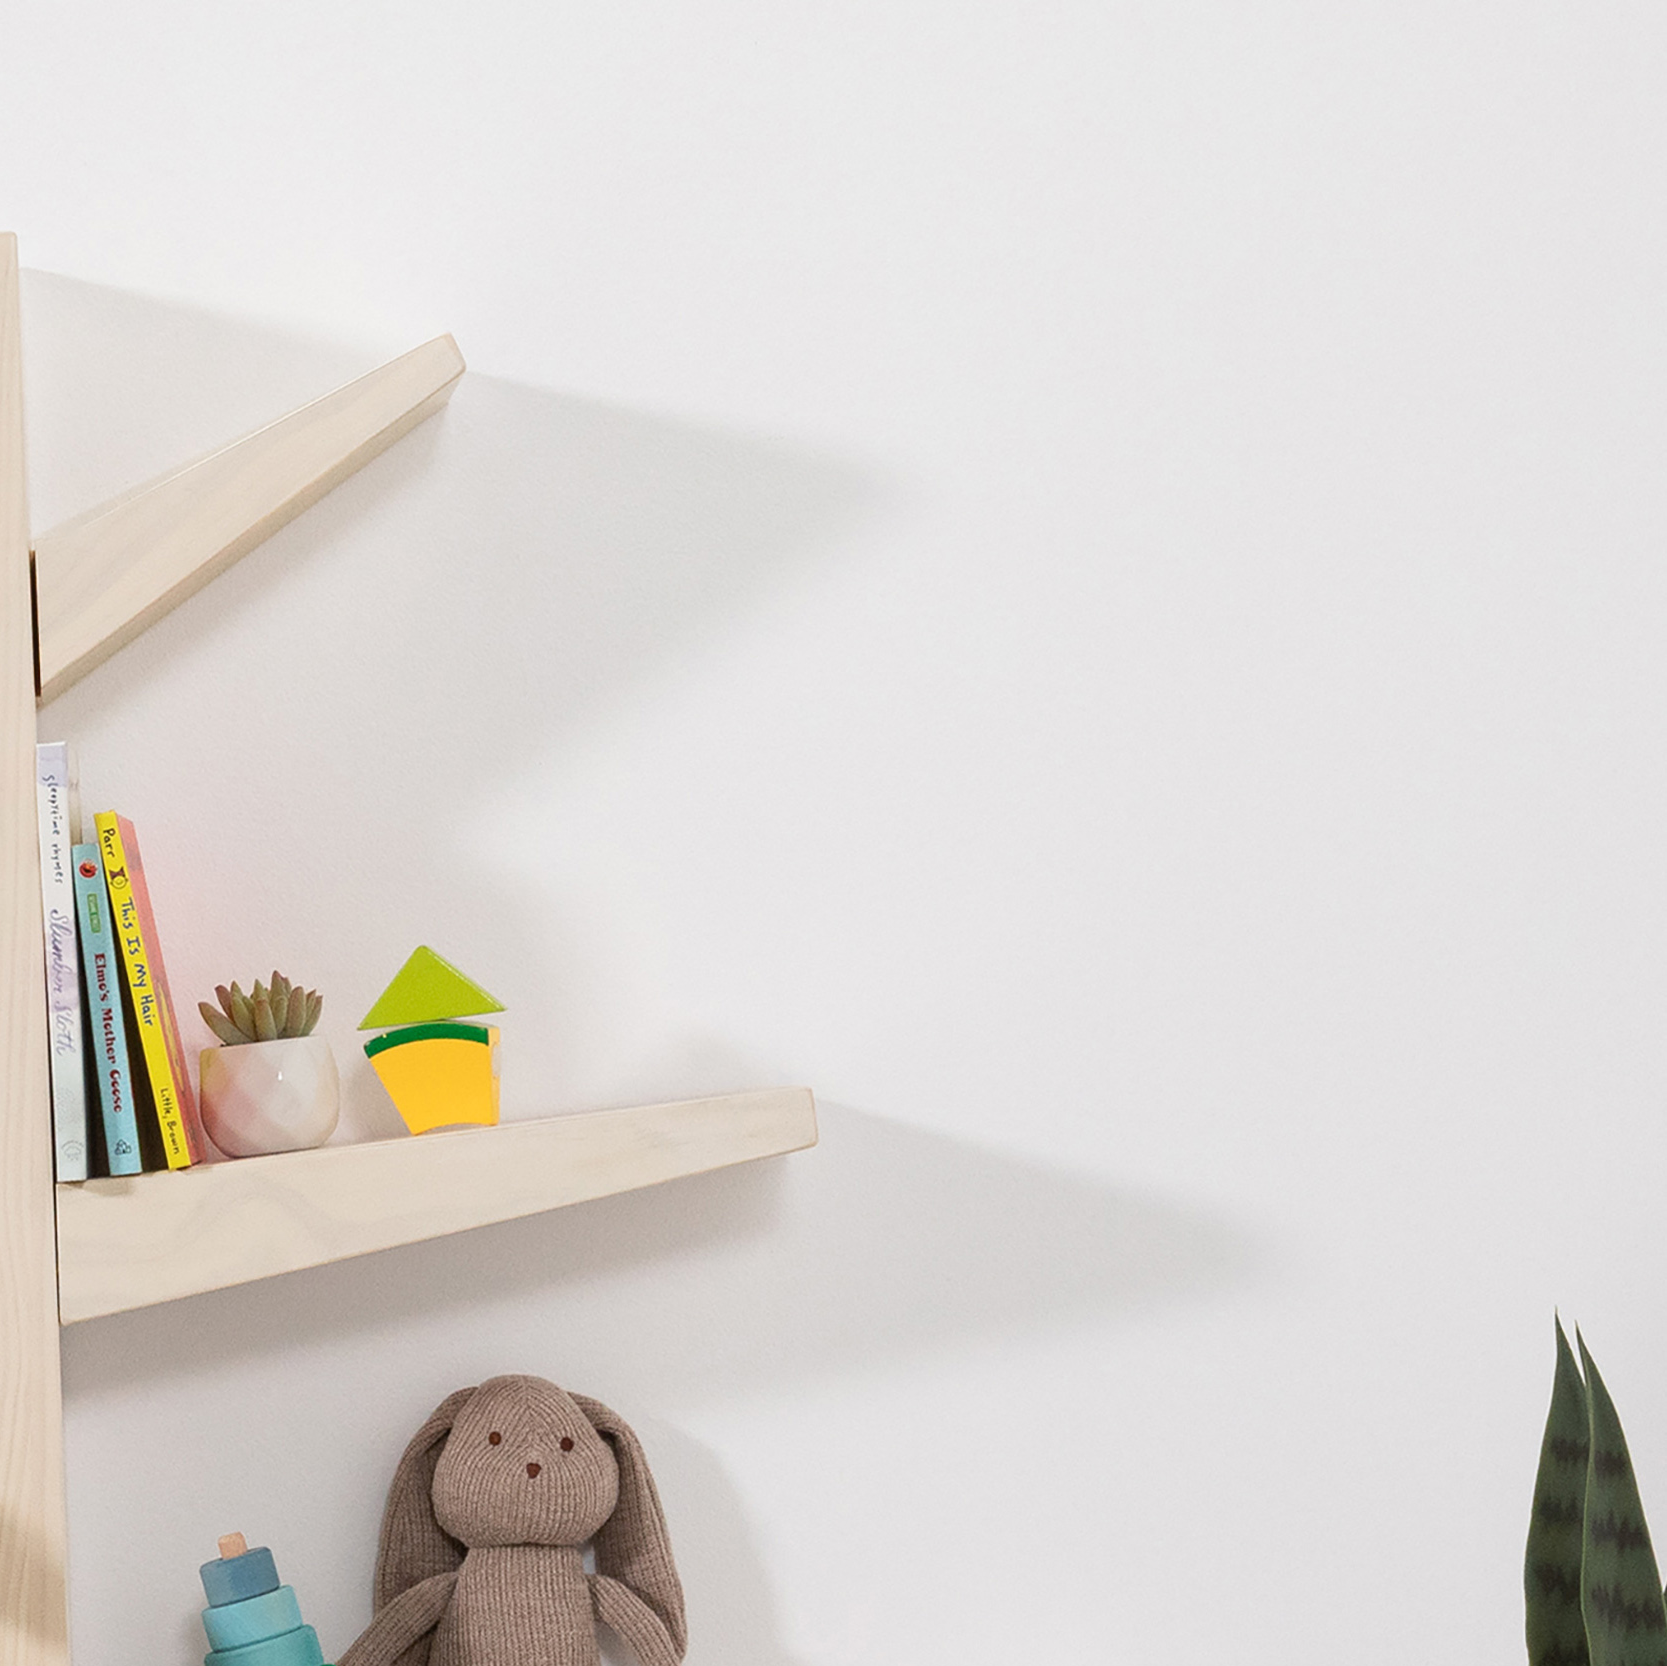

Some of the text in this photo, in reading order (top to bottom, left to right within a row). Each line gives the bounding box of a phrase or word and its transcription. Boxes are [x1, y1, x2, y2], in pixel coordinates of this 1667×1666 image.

[51, 844, 63, 884] rhymes
[103, 827, 116, 858] Parr
[50, 909, 76, 1056] Slumber Sloth
[122, 897, 154, 1026] This Is My Hair
[94, 953, 122, 1113] Elmo's Mother Goose
[167, 1121, 180, 1154] Brown
